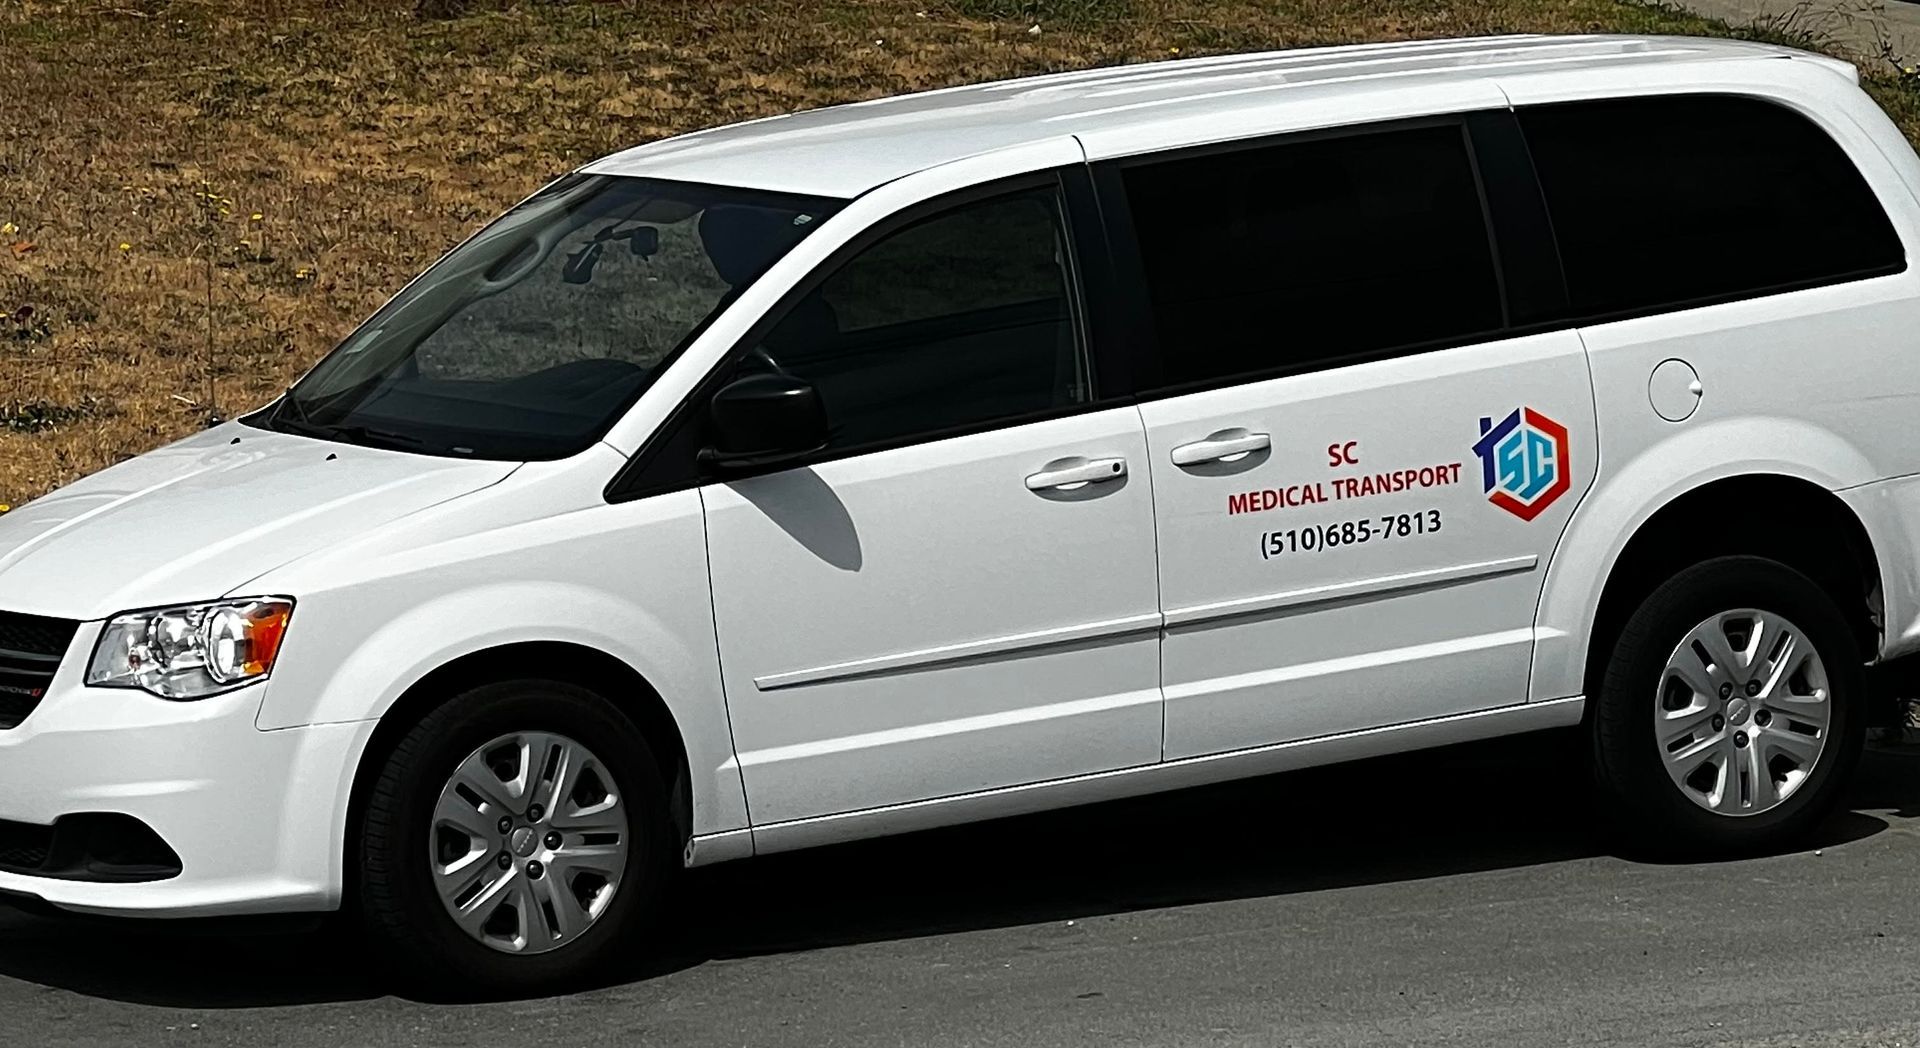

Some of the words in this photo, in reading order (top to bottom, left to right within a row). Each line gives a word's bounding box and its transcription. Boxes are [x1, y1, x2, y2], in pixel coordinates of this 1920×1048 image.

[1327, 441, 1359, 468] SC
[1498, 428, 1555, 501] SC
[1228, 483, 1329, 515] MEDICAL
[1331, 462, 1462, 500] TRANSPORT
[1261, 509, 1442, 560] (510)685-7813
